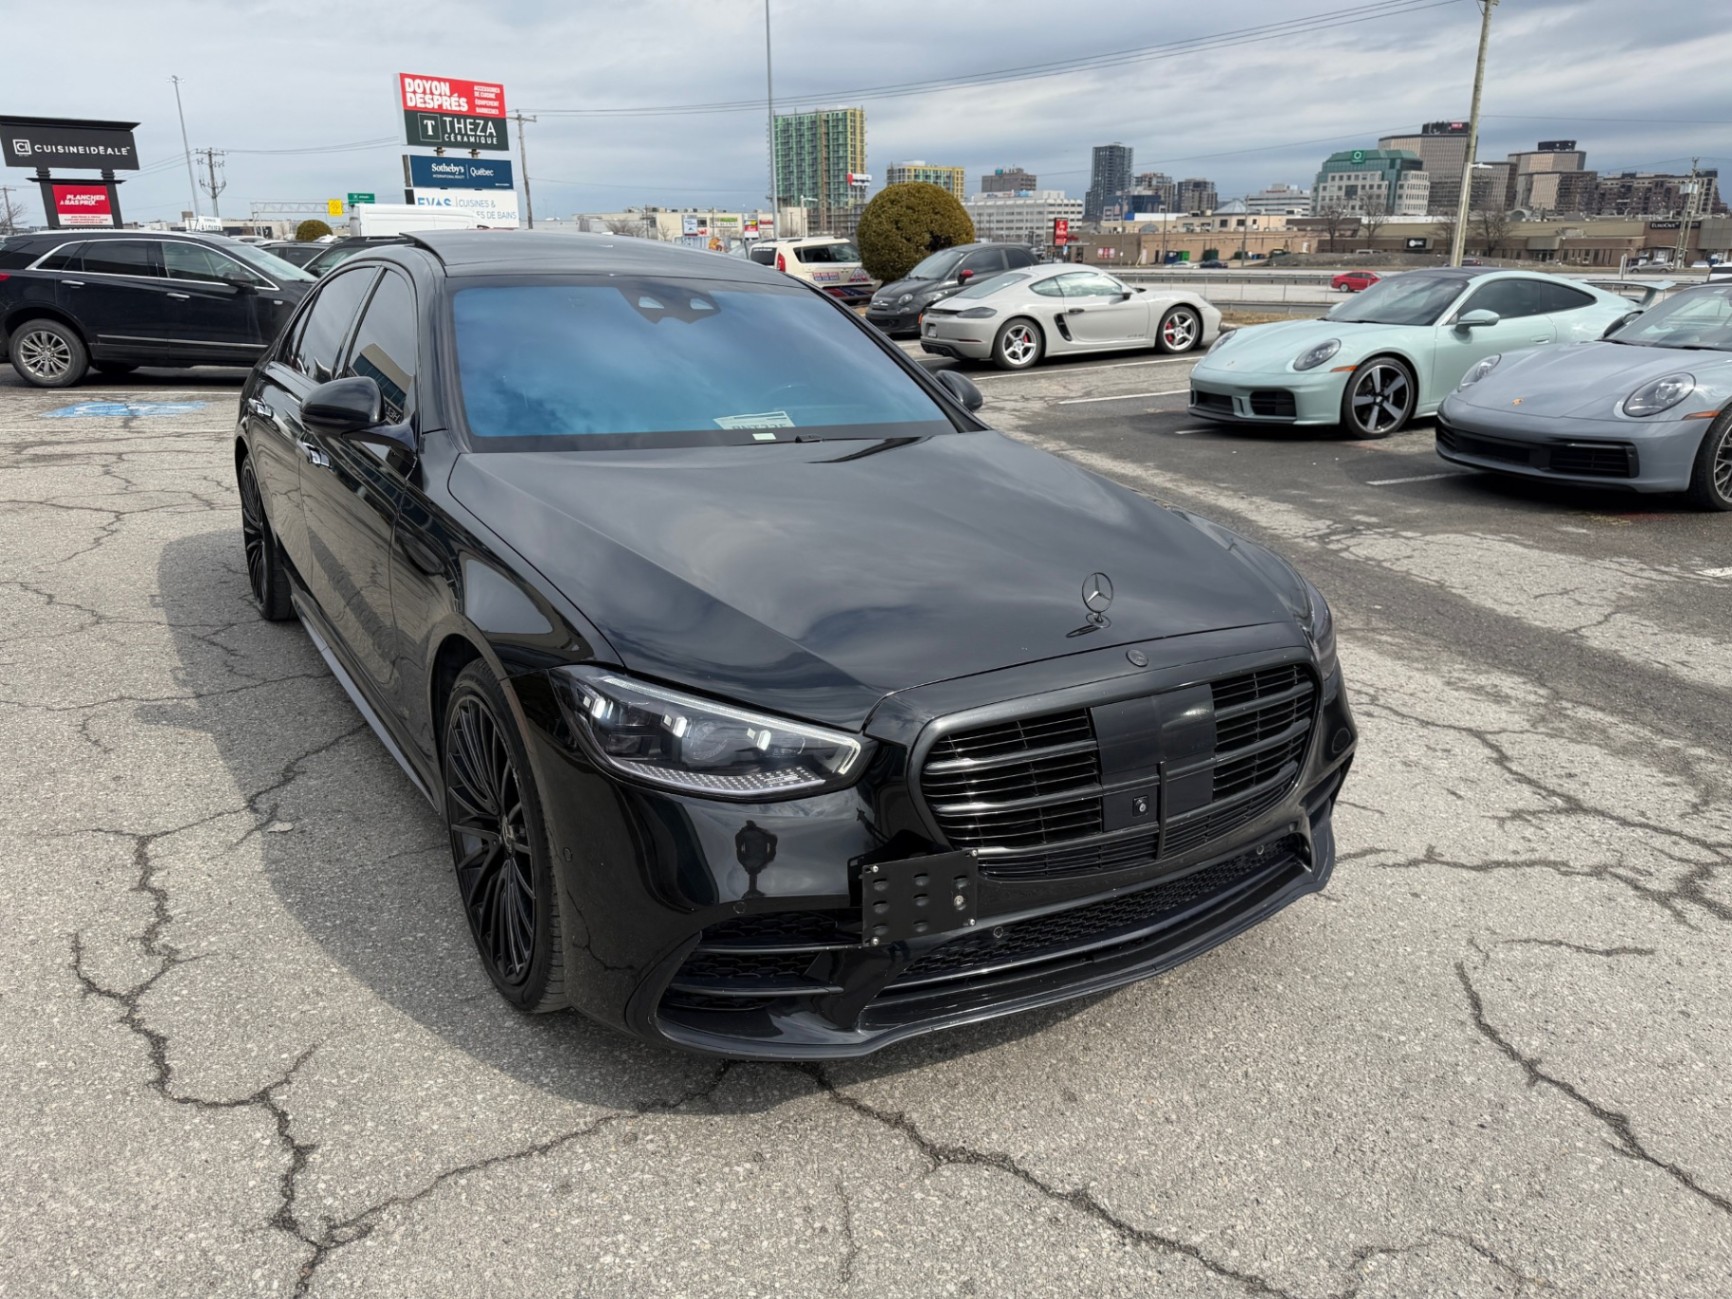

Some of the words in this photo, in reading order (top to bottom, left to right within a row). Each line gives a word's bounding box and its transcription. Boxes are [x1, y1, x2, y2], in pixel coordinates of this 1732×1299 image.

[404, 78, 450, 96] DOYON
[407, 93, 468, 111] DESPRÉS
[443, 117, 497, 137] THEZA
[444, 133, 498, 145] CÉRAMIQUE
[431, 163, 465, 175] Sotheby's
[470, 167, 494, 177] Québec
[458, 199, 490, 208] CUISINES
[486, 211, 497, 220] DE
[497, 211, 517, 220] BAINS
